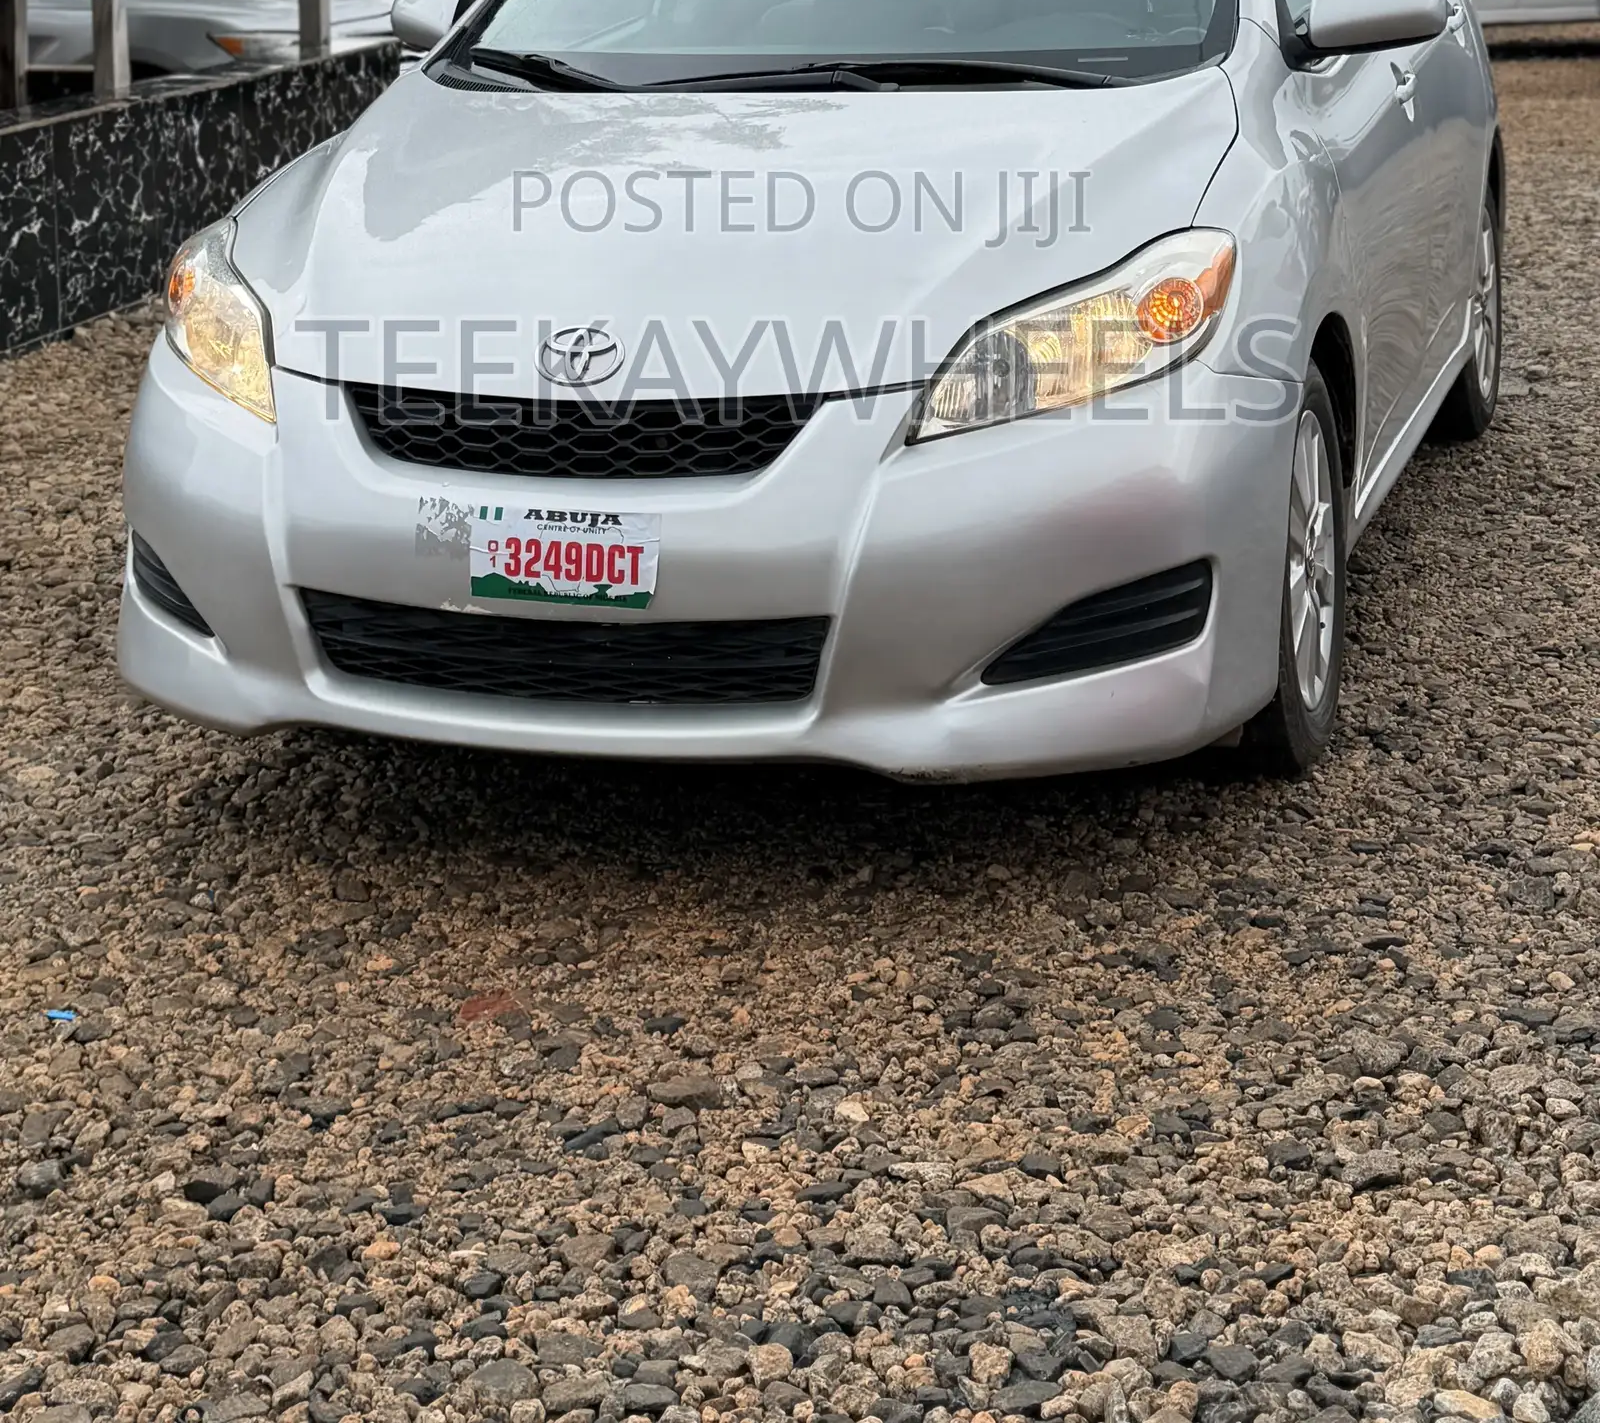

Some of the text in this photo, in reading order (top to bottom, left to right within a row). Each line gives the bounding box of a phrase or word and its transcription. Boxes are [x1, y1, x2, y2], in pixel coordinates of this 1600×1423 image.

[523, 508, 623, 528] ABUJA
[536, 523, 567, 533] CENTRE
[582, 526, 608, 535] UNITY
[504, 537, 645, 586] 3249DCT
